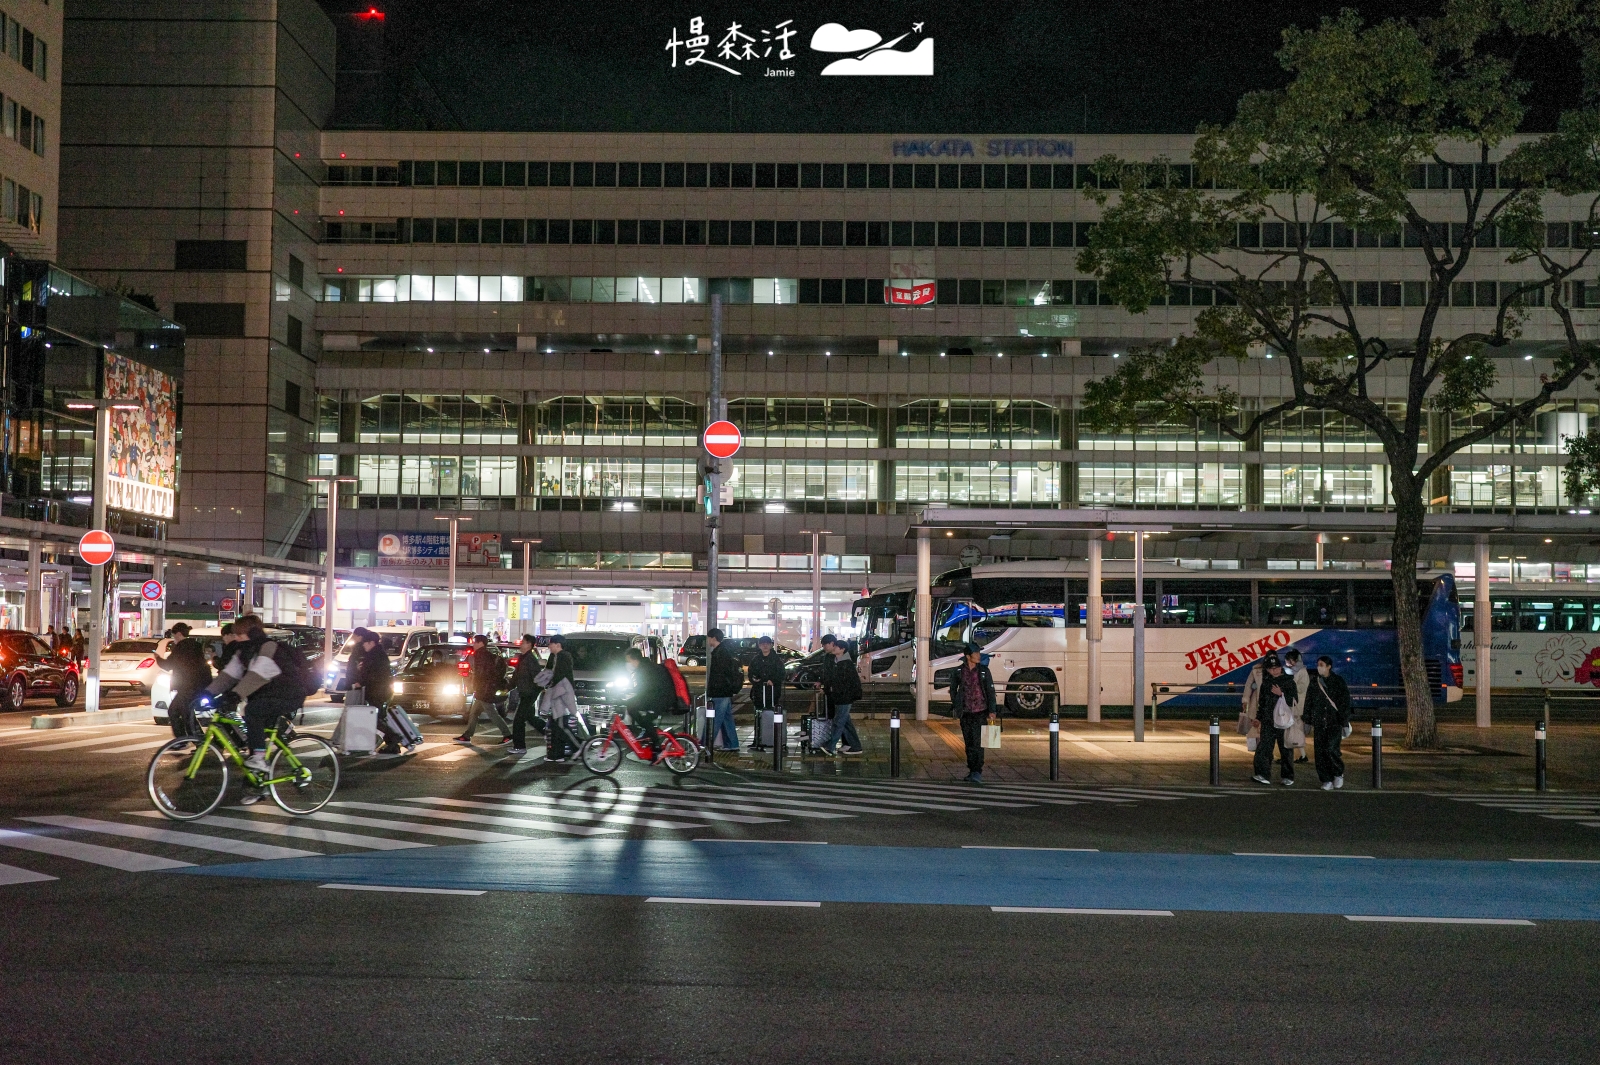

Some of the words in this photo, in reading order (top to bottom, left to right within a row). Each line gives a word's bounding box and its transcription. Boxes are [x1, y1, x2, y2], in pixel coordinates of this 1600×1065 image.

[892, 138, 975, 158] HAKATA
[987, 138, 1074, 158] STATION
[1184, 636, 1229, 671] JET
[1205, 629, 1291, 679] KANKO
